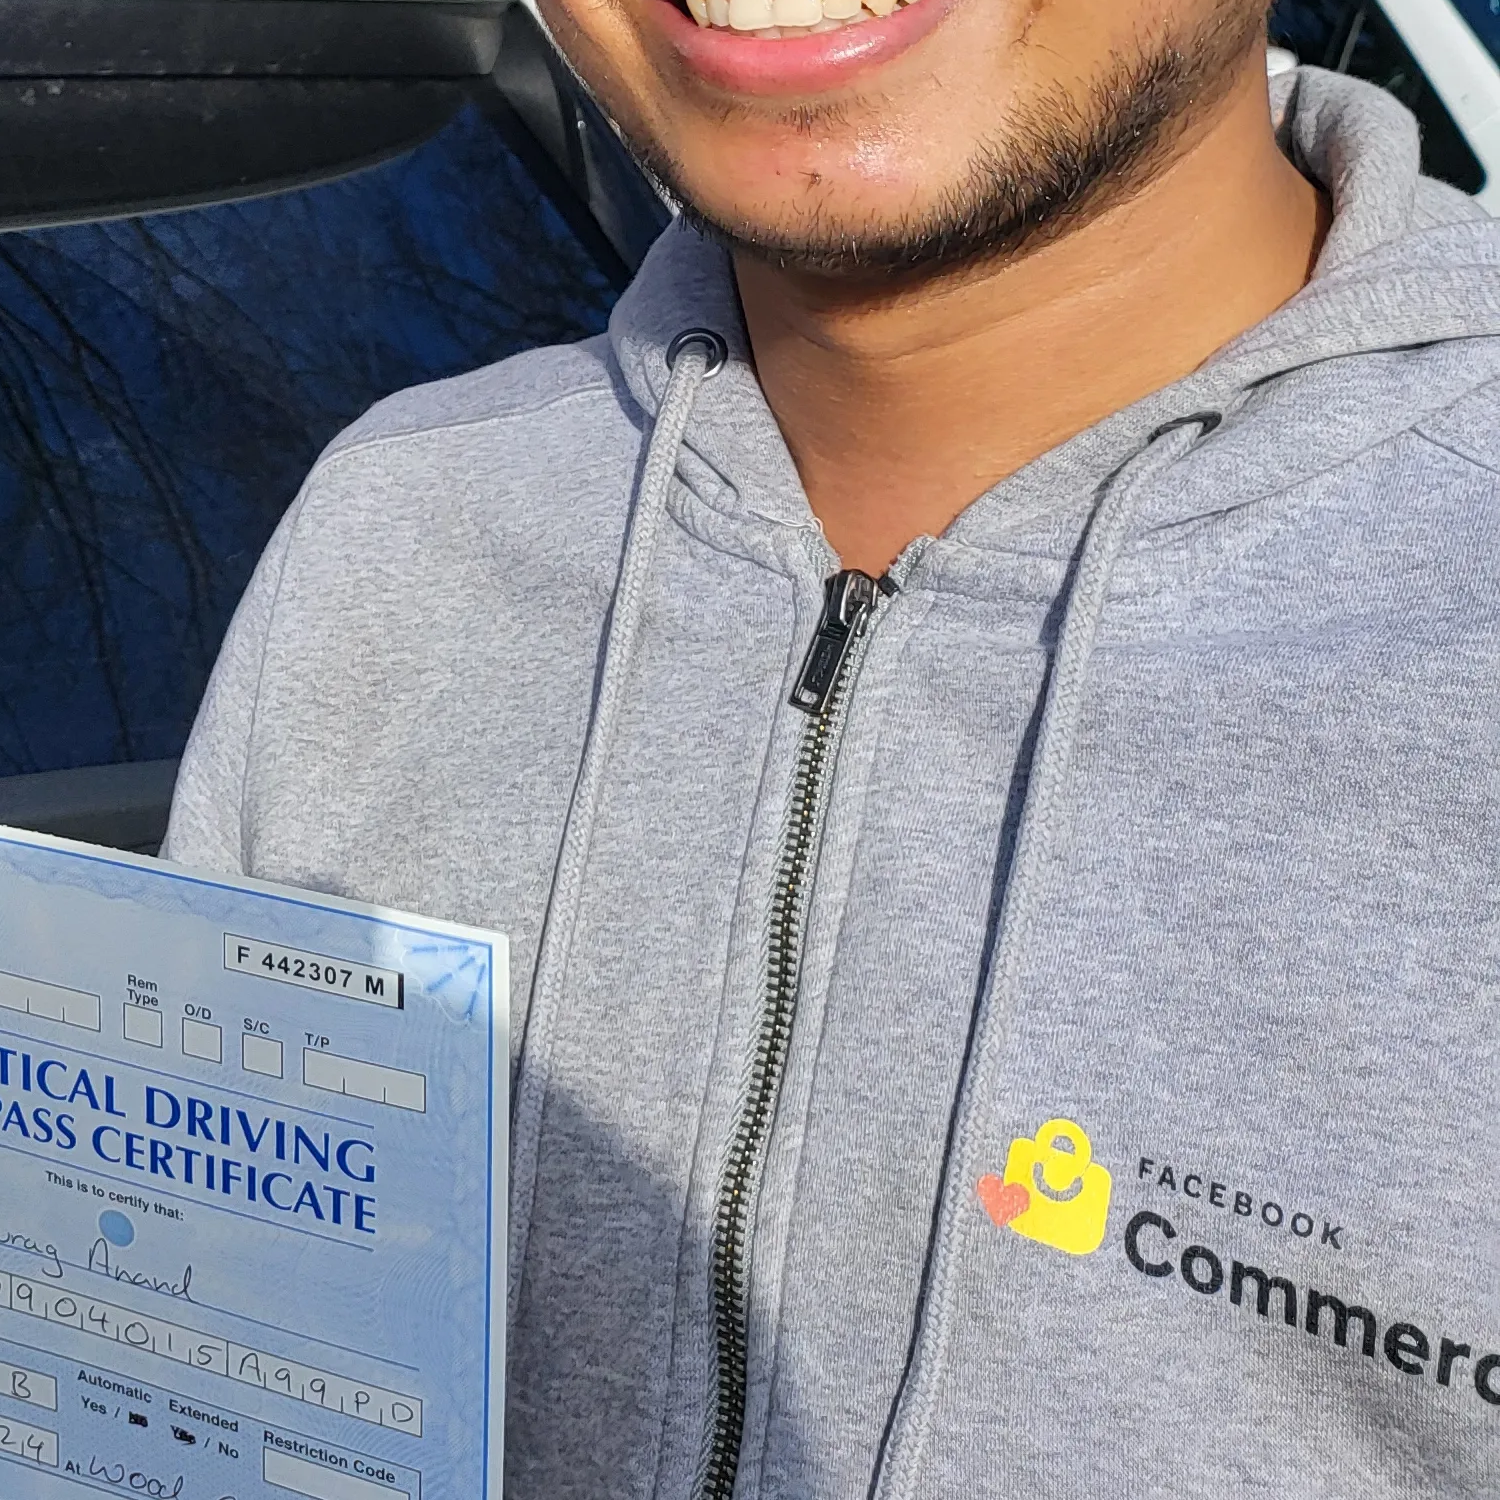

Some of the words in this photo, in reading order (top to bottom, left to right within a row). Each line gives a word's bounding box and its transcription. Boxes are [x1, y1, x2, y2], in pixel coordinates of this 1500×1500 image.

[127, 974, 157, 992] Rem
[236, 945, 250, 963] F
[261, 952, 352, 988] 442307
[365, 974, 384, 996] M
[127, 988, 159, 1007] Type
[184, 1003, 212, 1020] O/D
[243, 1018, 270, 1035] S/C
[304, 1032, 330, 1048] T/P
[144, 1085, 376, 1183] DRIVING
[92, 1126, 376, 1234] CERTIFICATE
[46, 1170, 73, 1188] This
[77, 1179, 88, 1192] is
[92, 1185, 105, 1197] to
[109, 1191, 149, 1212] certify
[154, 1202, 184, 1221] that:
[1139, 1157, 1345, 1250] FACEBOOK
[89, 1237, 193, 1301] Anand
[11, 1371, 31, 1399] B
[77, 1369, 152, 1403] Automatic
[81, 1395, 107, 1415] Yes
[169, 1399, 239, 1432] Extended
[218, 1441, 239, 1459] No
[263, 1430, 348, 1469] Restriction
[353, 1459, 396, 1484] Code
[65, 1460, 81, 1475] At
